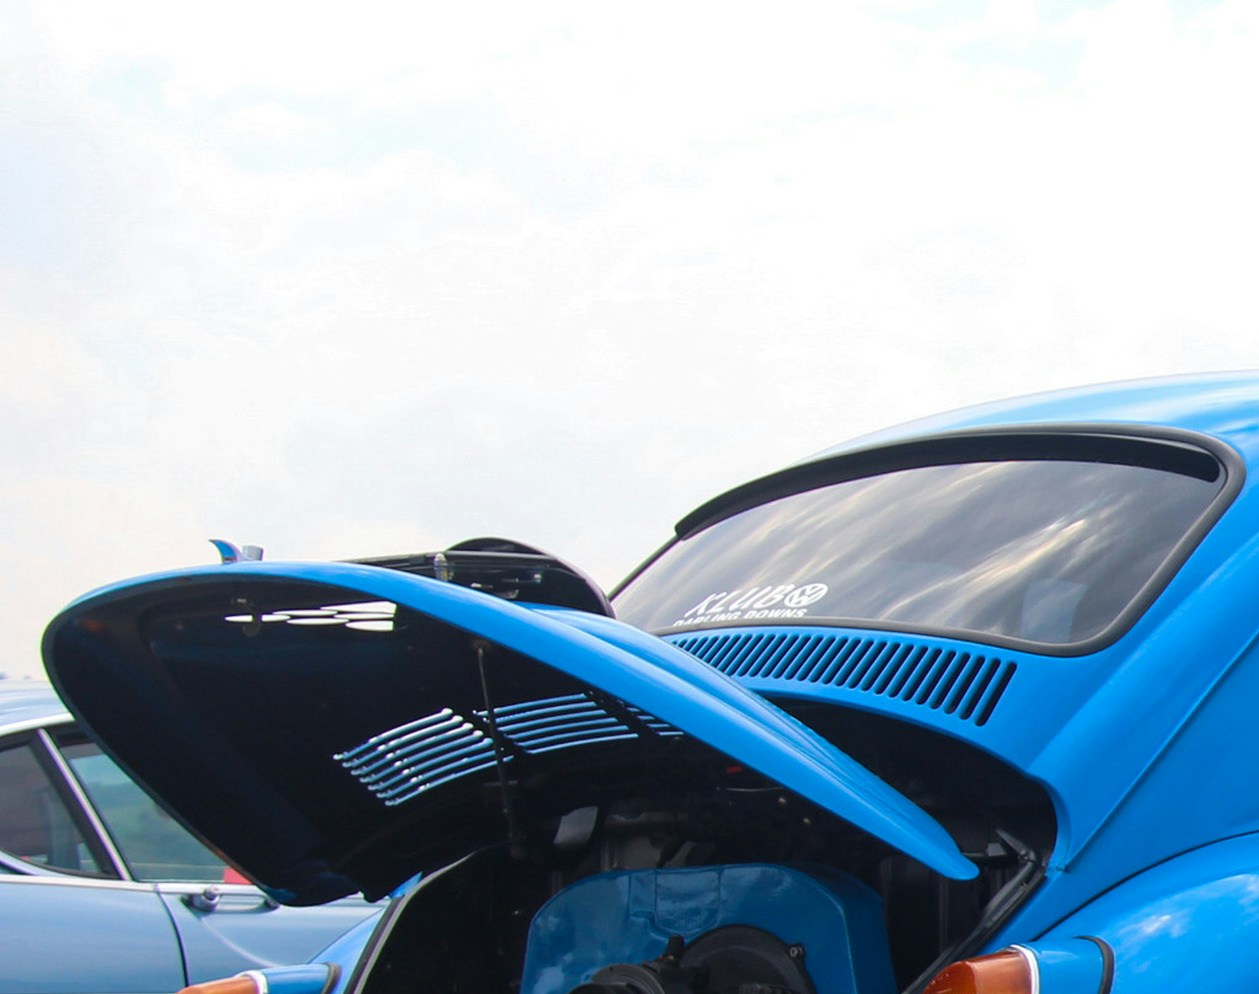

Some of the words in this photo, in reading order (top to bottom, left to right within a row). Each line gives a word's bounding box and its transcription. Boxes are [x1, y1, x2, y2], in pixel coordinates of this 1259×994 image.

[684, 584, 796, 619] KLUB
[672, 611, 739, 627] DARLING
[744, 608, 808, 619] DOWNS
